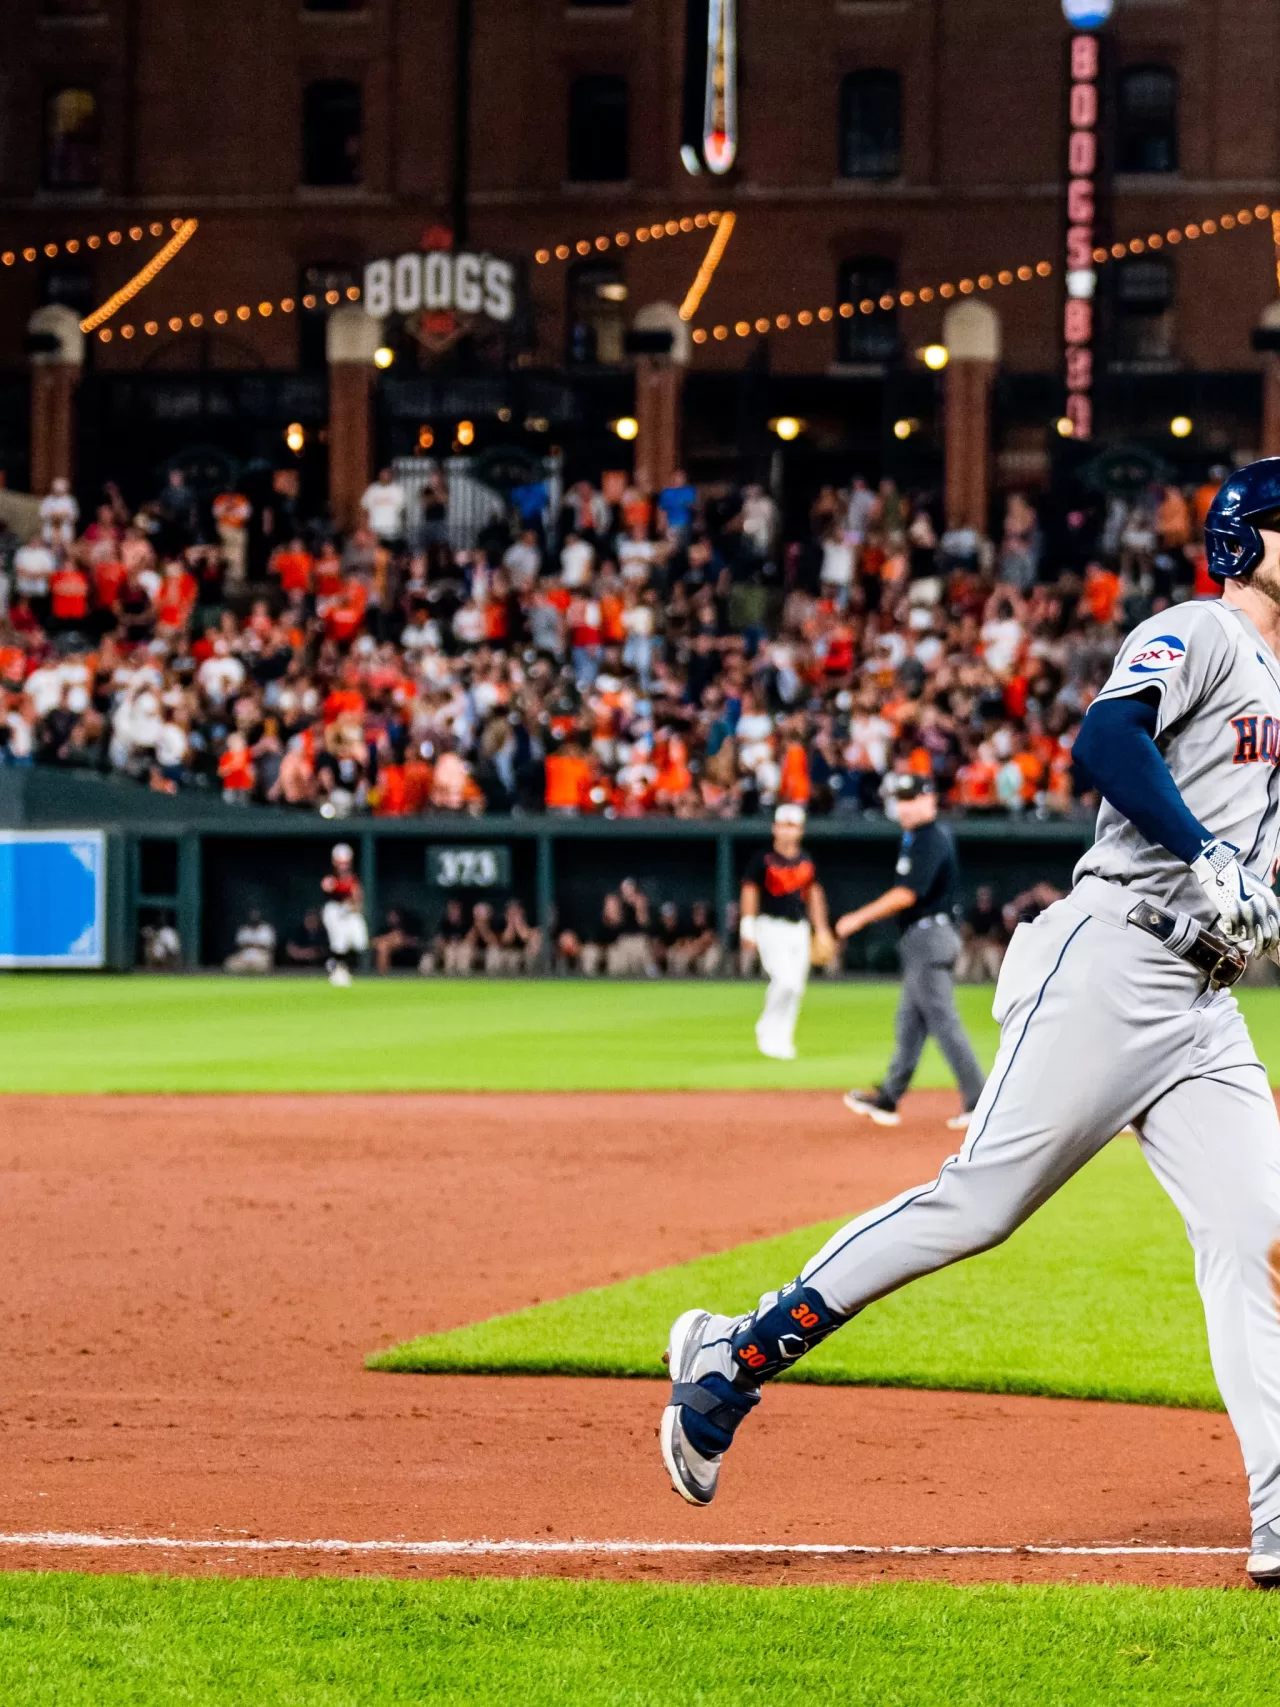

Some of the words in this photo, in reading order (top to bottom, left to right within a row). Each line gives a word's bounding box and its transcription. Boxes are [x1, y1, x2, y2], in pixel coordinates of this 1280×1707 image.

[1130, 649, 1185, 664] OXY
[438, 850, 495, 887] 373
[790, 1302, 820, 1329] 30
[738, 1343, 767, 1369] 30
